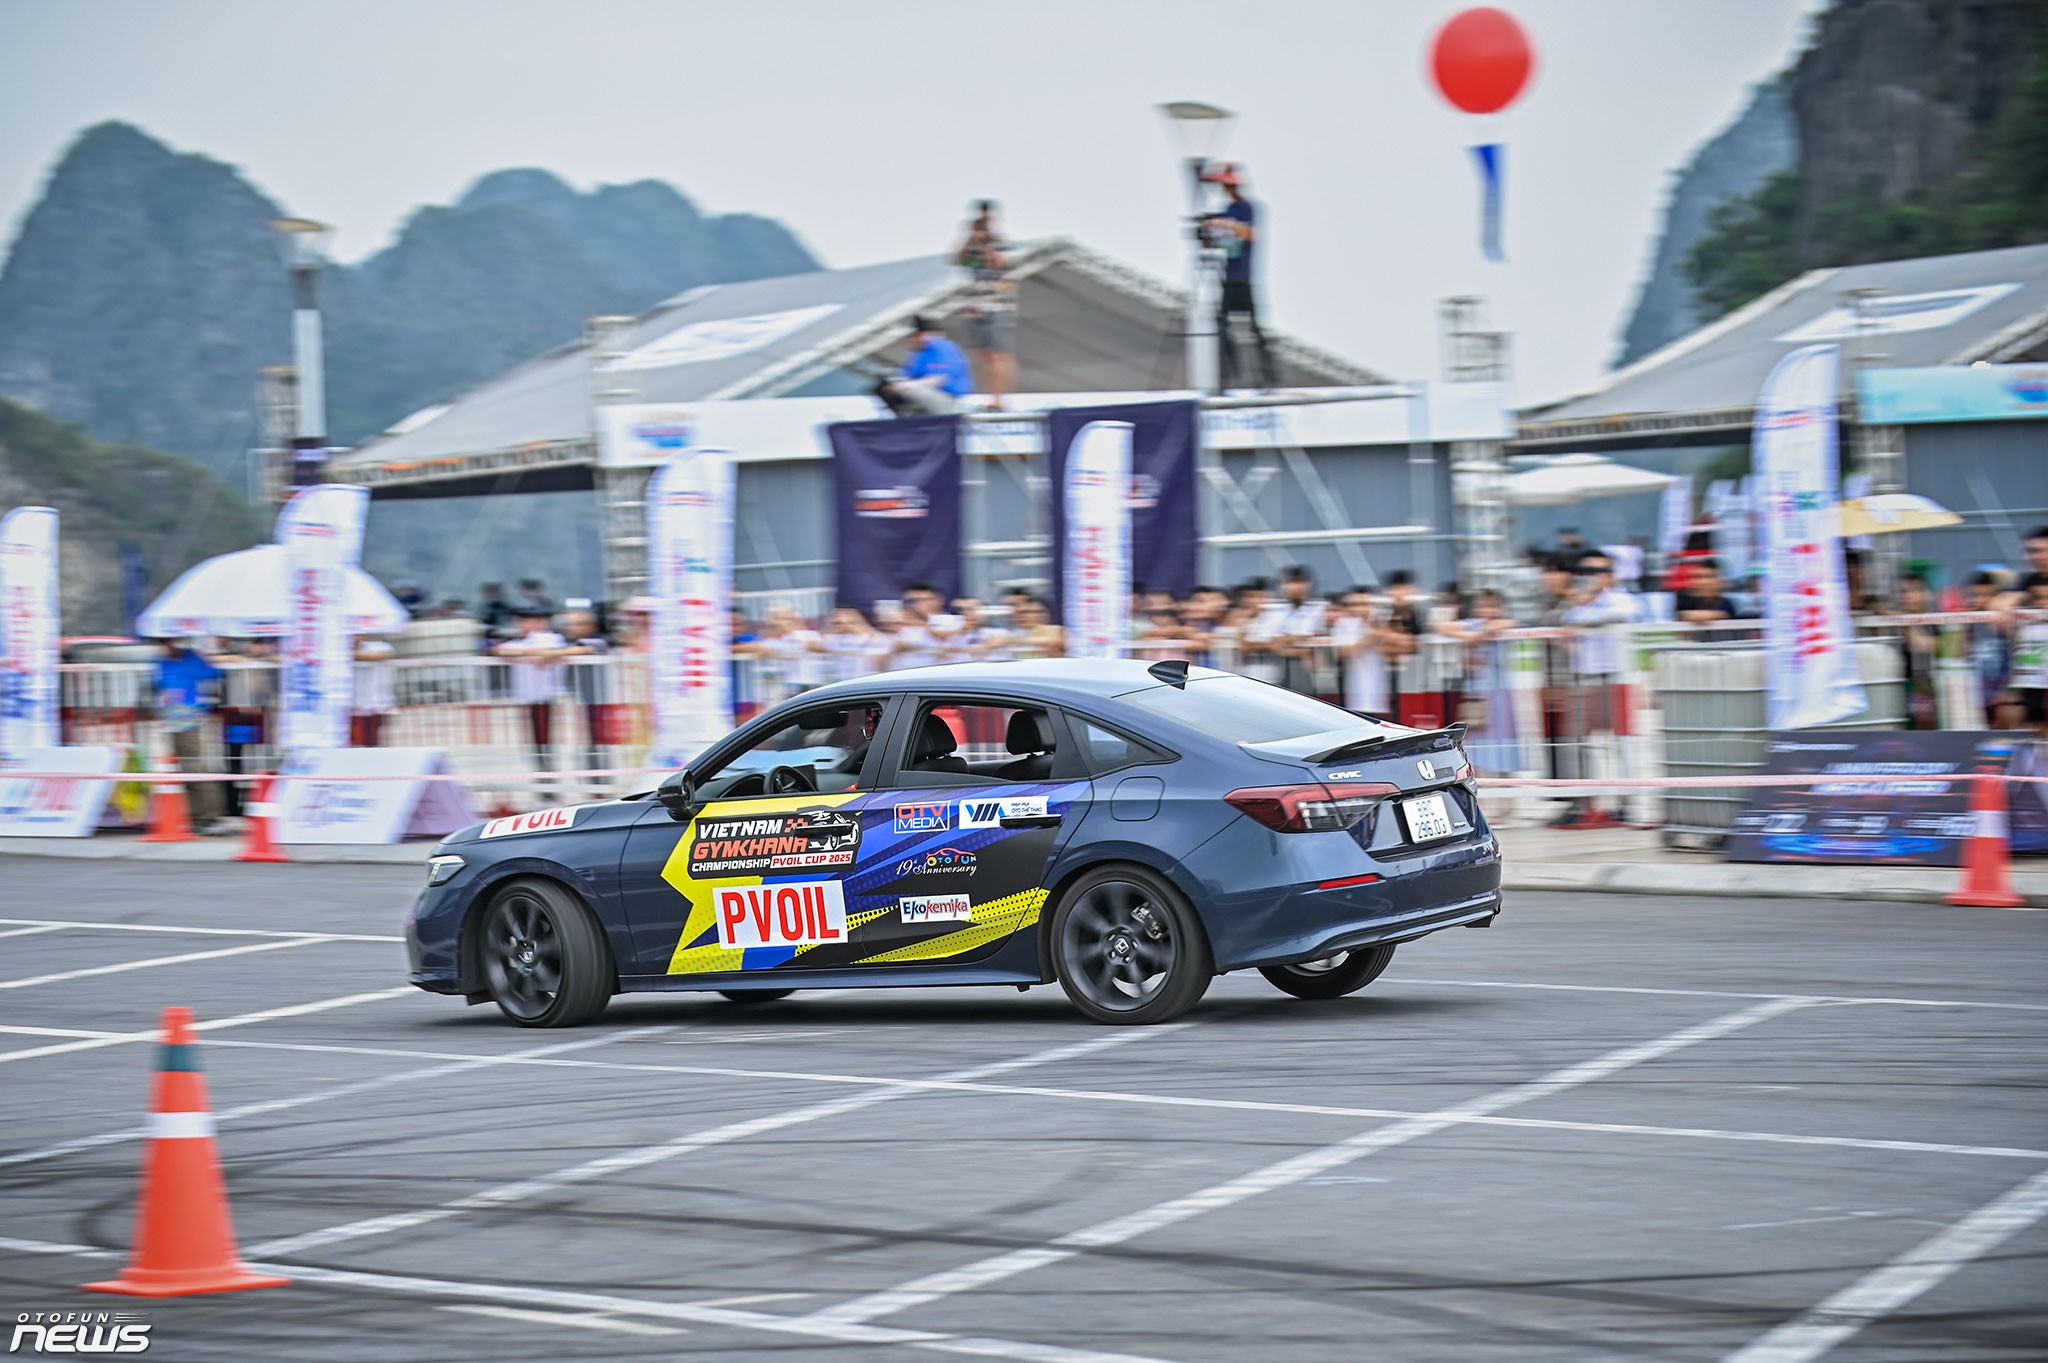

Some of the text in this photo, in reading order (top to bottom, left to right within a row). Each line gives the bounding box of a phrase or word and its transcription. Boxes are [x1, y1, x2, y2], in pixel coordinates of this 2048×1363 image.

[700, 819, 783, 839] VIETNAM
[899, 816, 948, 830] MEDIA
[693, 837, 809, 860] GYMKHANA
[692, 853, 851, 873] CHAMPIONSHIP PVOIL CUP 2025
[912, 861, 977, 878] Anniversary
[721, 886, 840, 944] PVOIL
[902, 898, 968, 920] Ekokemika
